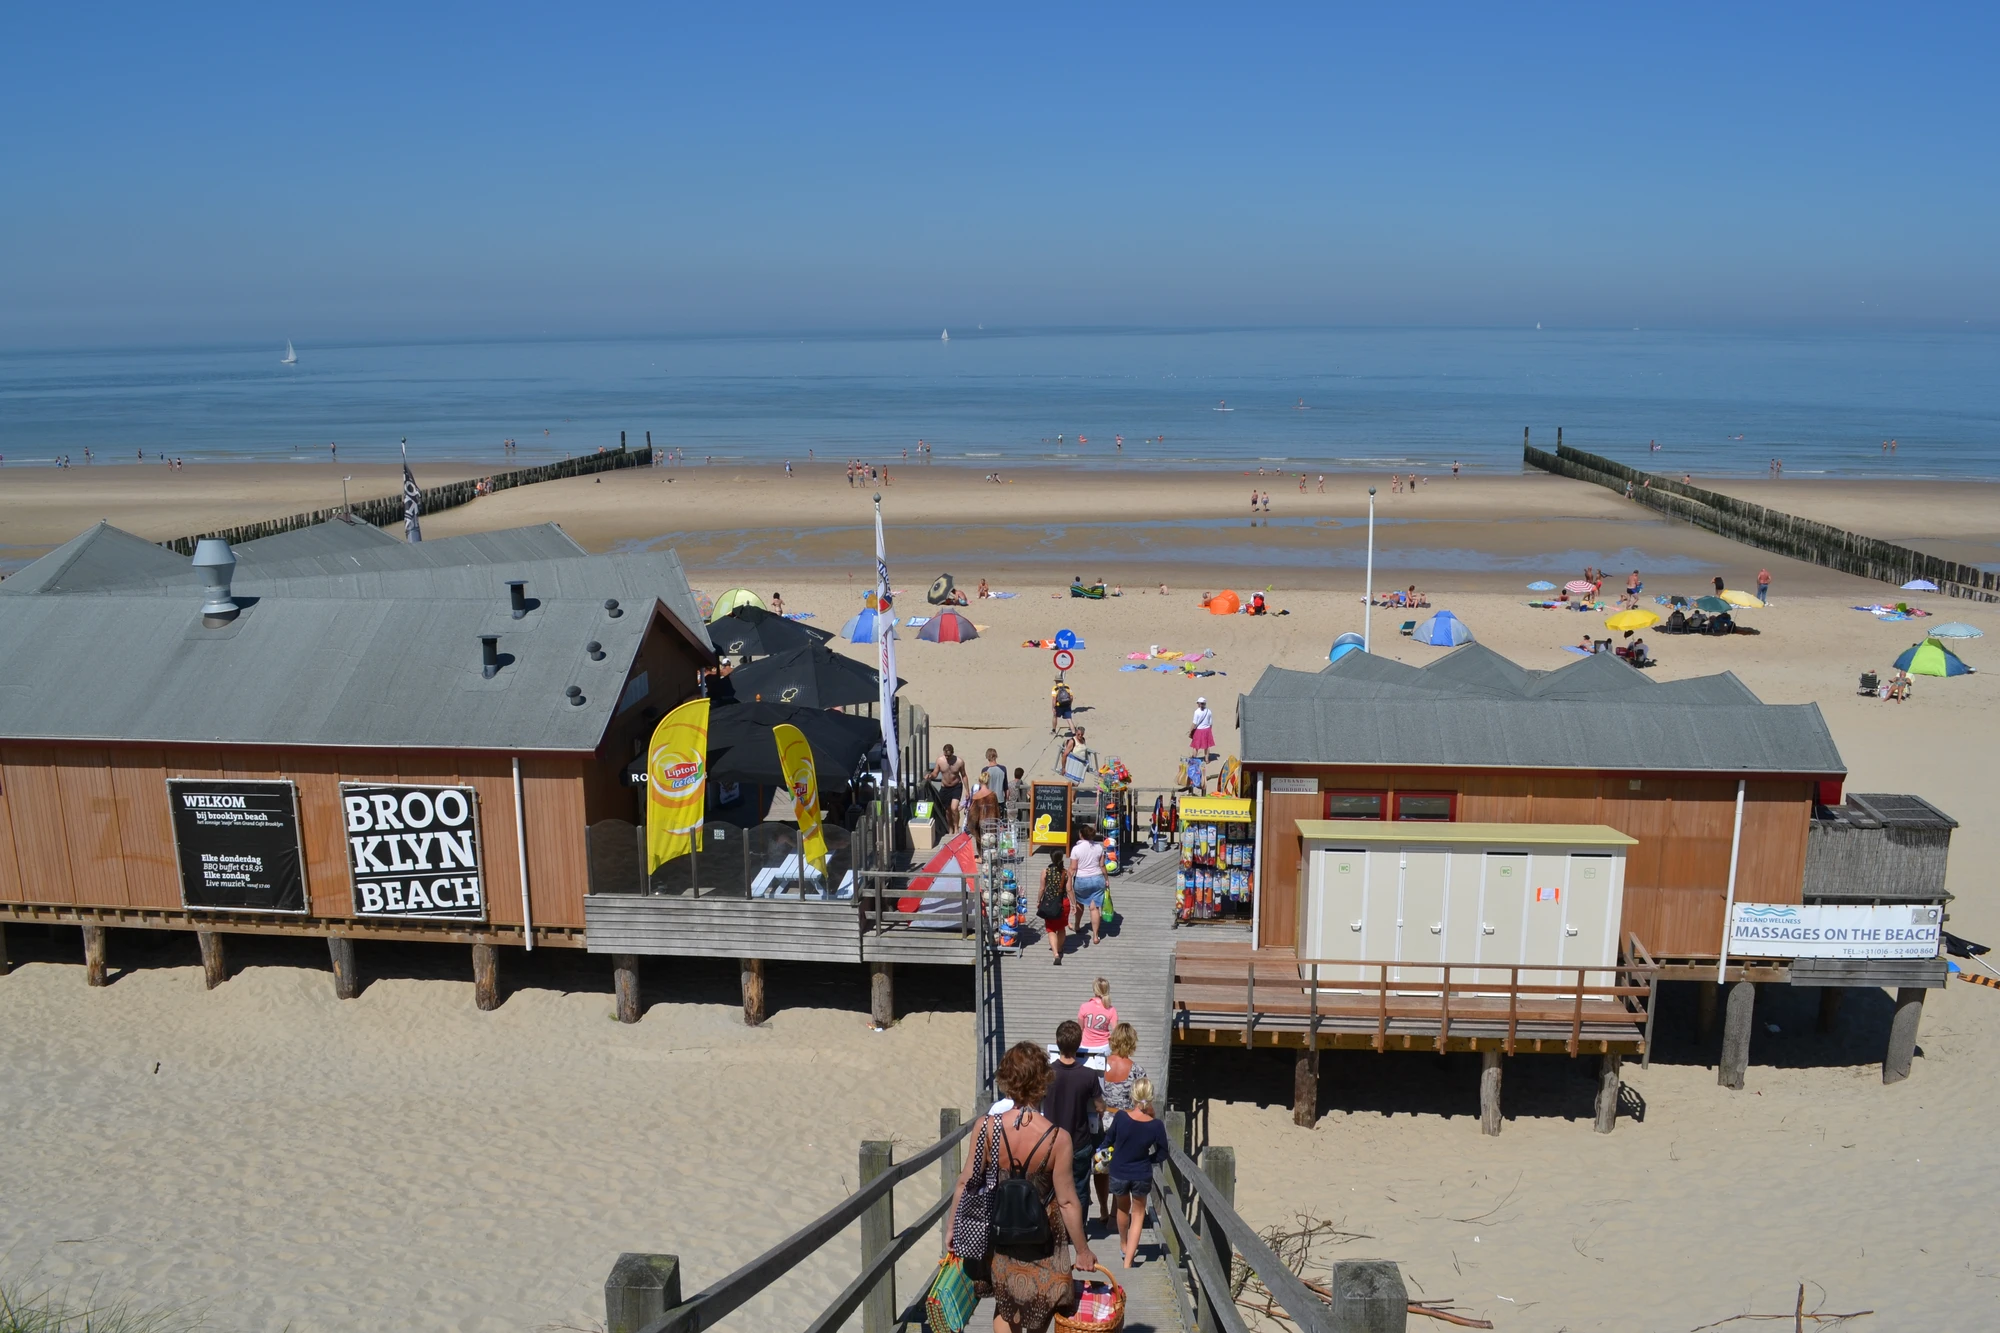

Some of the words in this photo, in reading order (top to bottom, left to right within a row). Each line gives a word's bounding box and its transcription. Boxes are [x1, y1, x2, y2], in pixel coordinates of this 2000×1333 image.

[667, 765, 696, 778] Lipton
[183, 795, 246, 808] WELKOM
[196, 811, 207, 821] bij
[207, 811, 244, 821] brooklyn
[244, 812, 268, 821] beach
[345, 790, 468, 832] BROO
[1185, 808, 1252, 816] RHOMBUS
[350, 830, 476, 874] KLYN
[201, 854, 218, 862] Elke
[219, 854, 261, 865] donderdag
[203, 863, 218, 872] BBQ
[219, 863, 240, 873] buffet
[203, 871, 221, 879] Elke
[222, 871, 251, 882] zondag
[220, 880, 246, 888] muziek
[358, 877, 480, 912] BEACH
[1768, 917, 1802, 925] WELLNESS
[1735, 925, 1820, 941] MASSAGES
[1824, 928, 1849, 941] ON
[1851, 928, 1881, 941] THE
[1885, 928, 1936, 941] BEACH
[1086, 1013, 1107, 1030] 12
